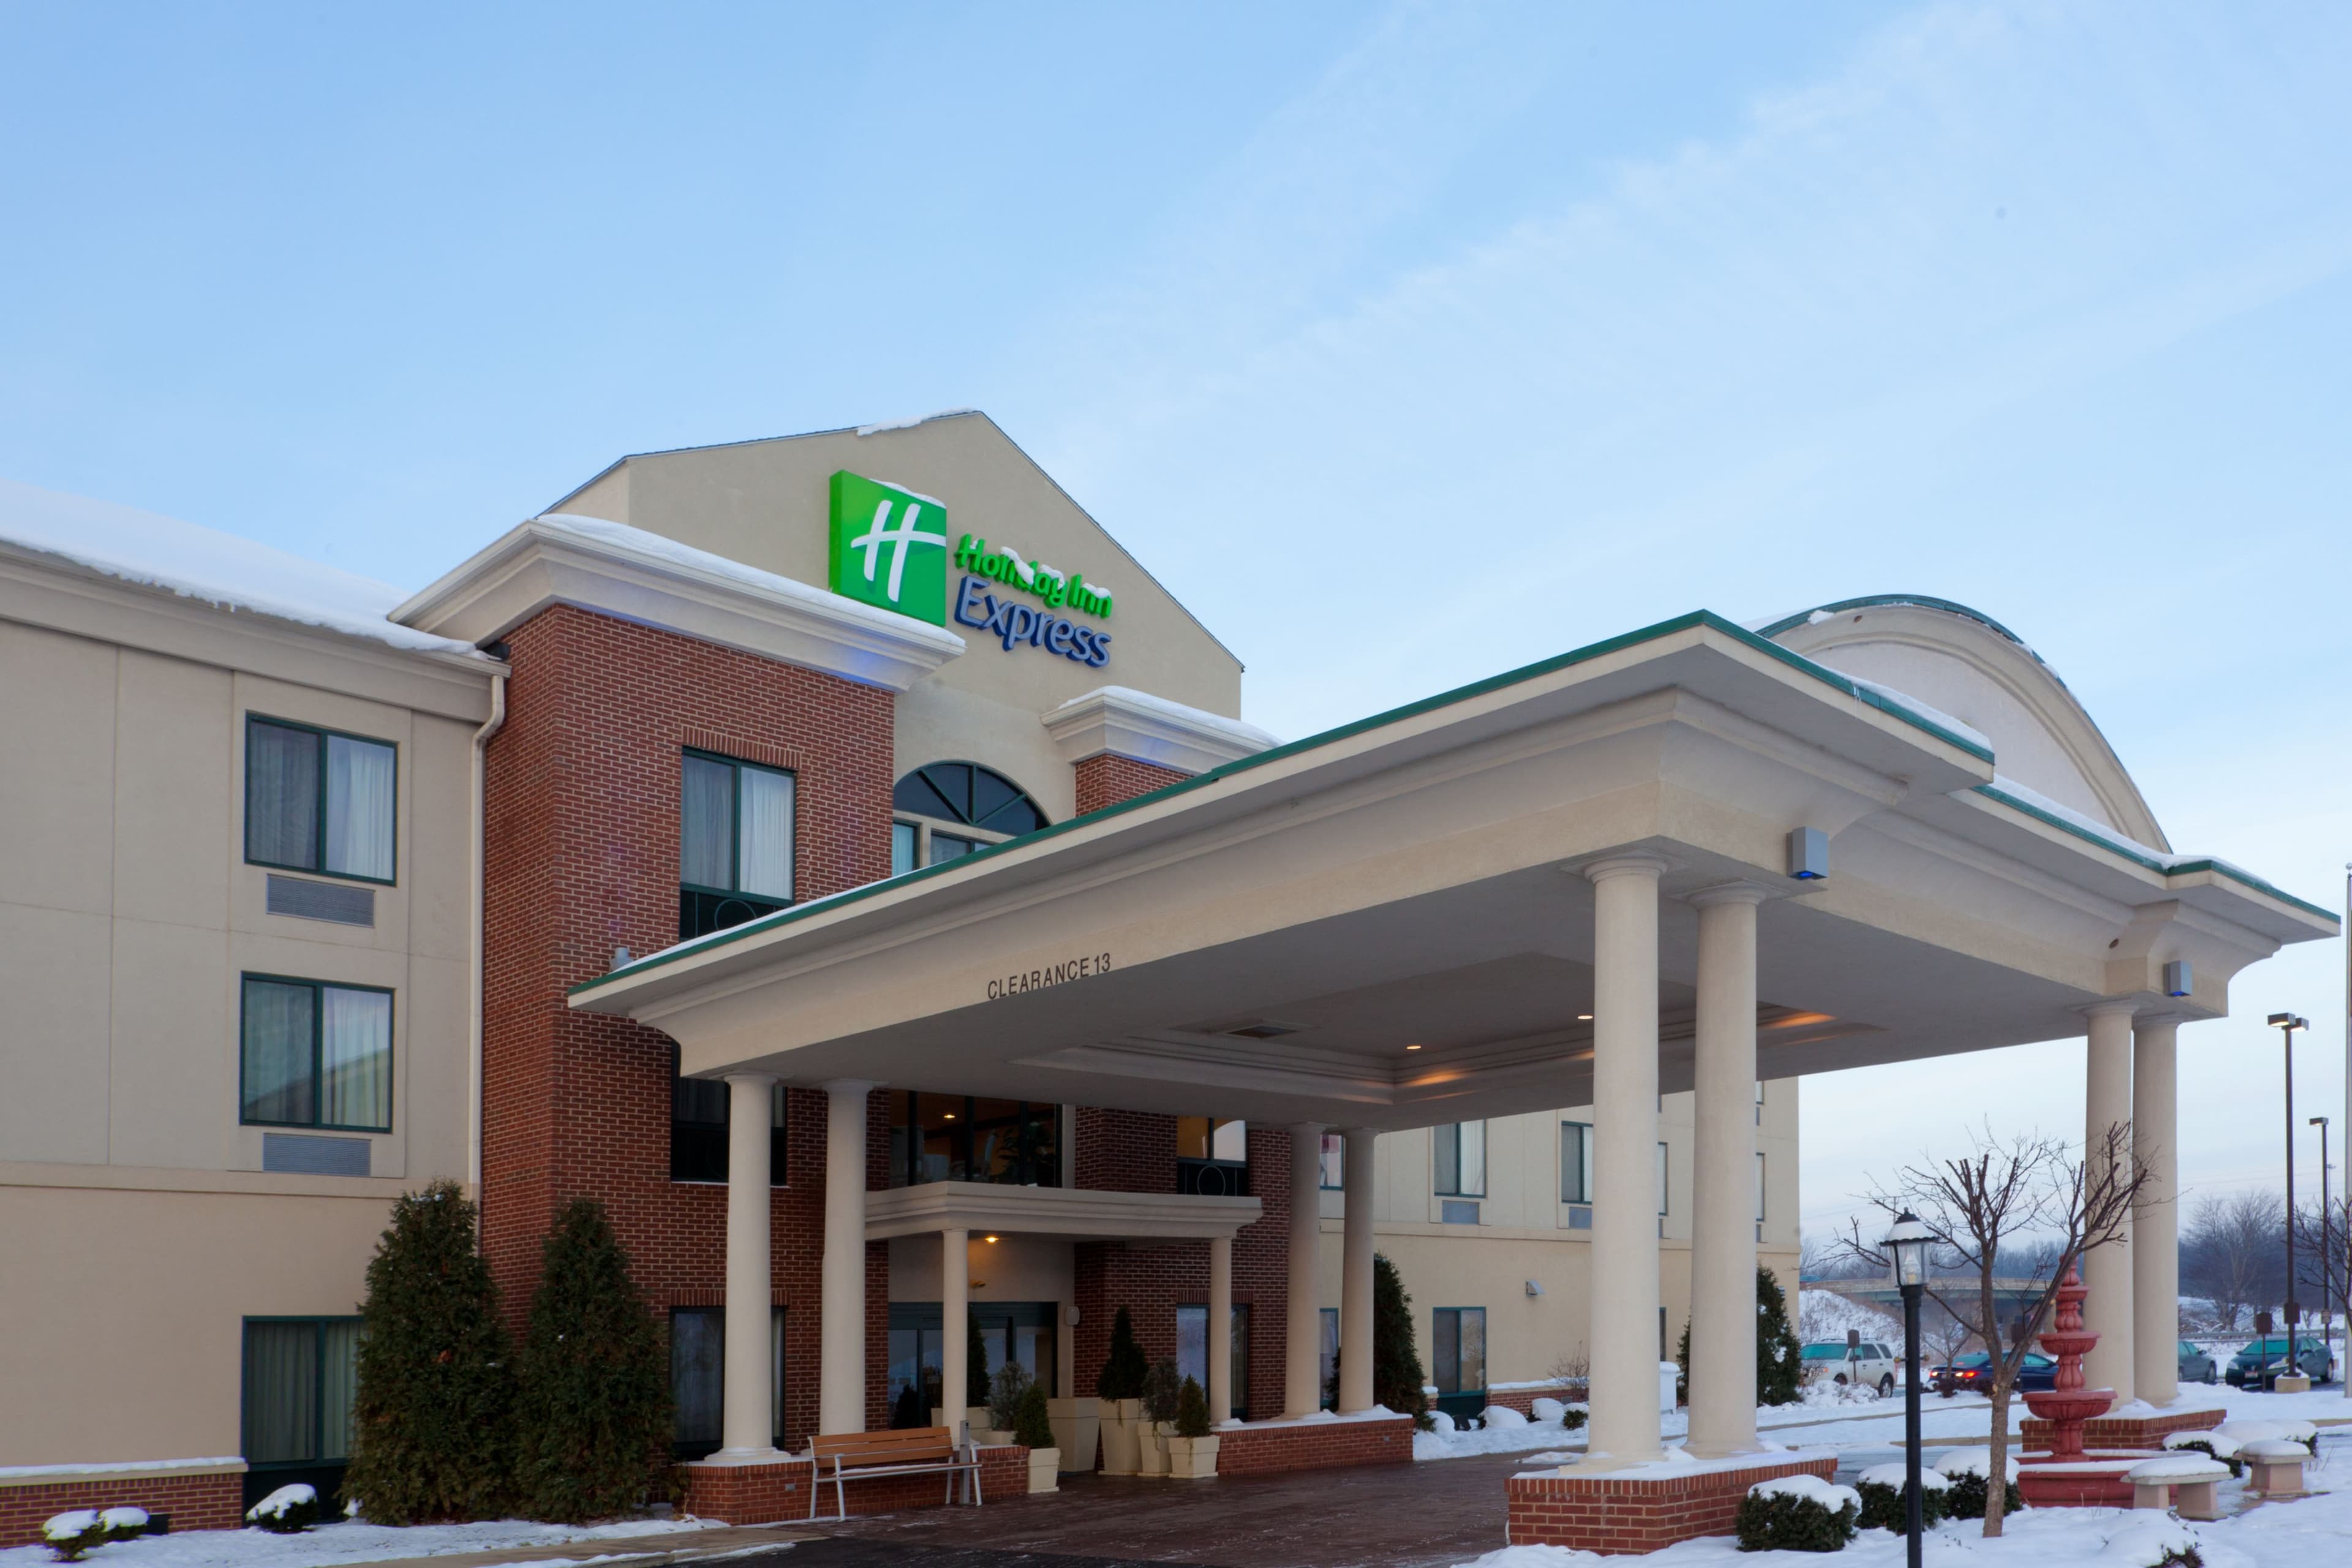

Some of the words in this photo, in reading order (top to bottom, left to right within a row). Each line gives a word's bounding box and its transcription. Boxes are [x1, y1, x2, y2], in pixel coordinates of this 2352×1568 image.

[1067, 574, 1112, 619] Inn
[954, 575, 1112, 668] Express
[987, 957, 1089, 1000] CLEARANCE
[1094, 952, 1110, 974] 13
